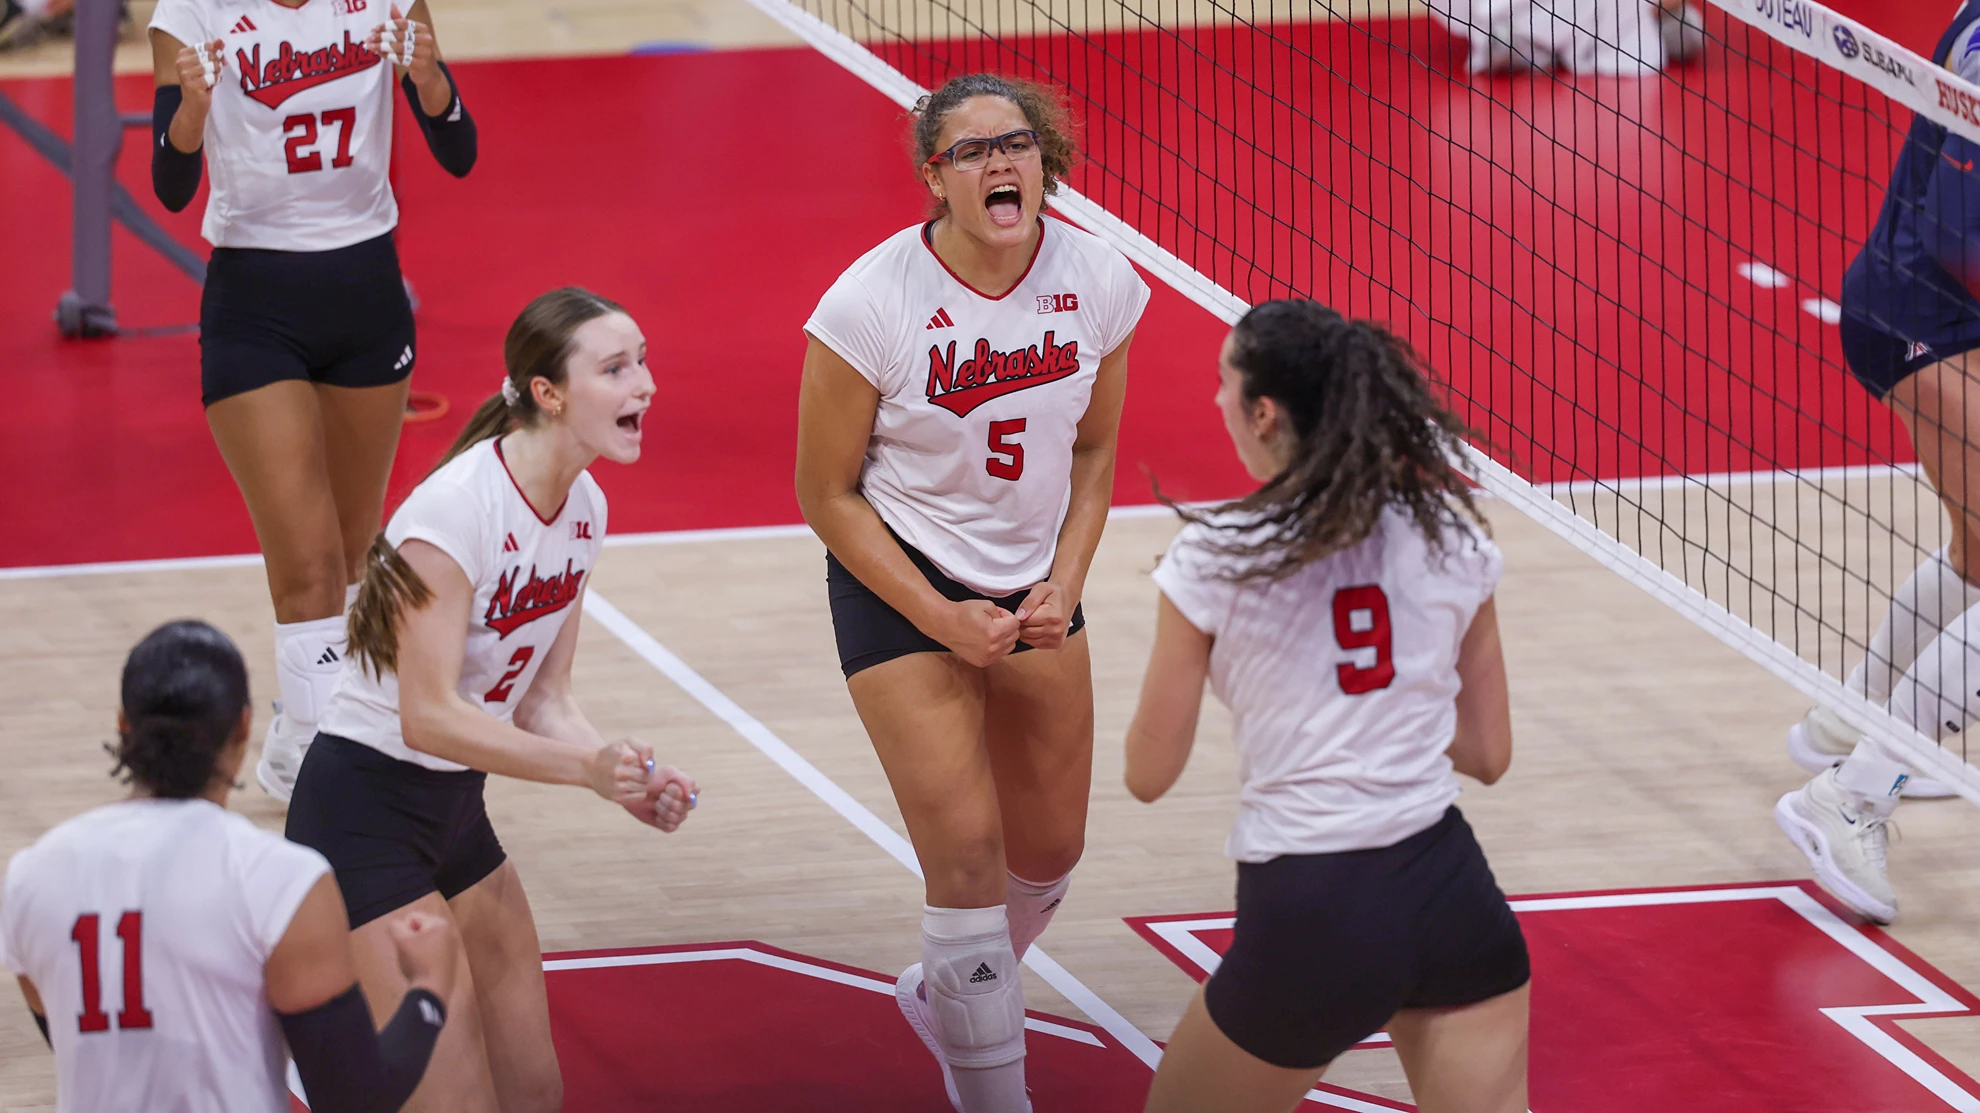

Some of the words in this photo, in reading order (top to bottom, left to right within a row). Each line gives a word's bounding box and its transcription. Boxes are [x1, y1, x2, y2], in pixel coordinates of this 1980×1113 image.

[283, 106, 357, 175] 27
[925, 330, 1080, 398] Nebraska
[985, 417, 1027, 482] 5
[1331, 583, 1396, 696] 9
[484, 646, 535, 703] 2
[71, 910, 154, 1034] 11
[969, 973, 997, 984] adidas
